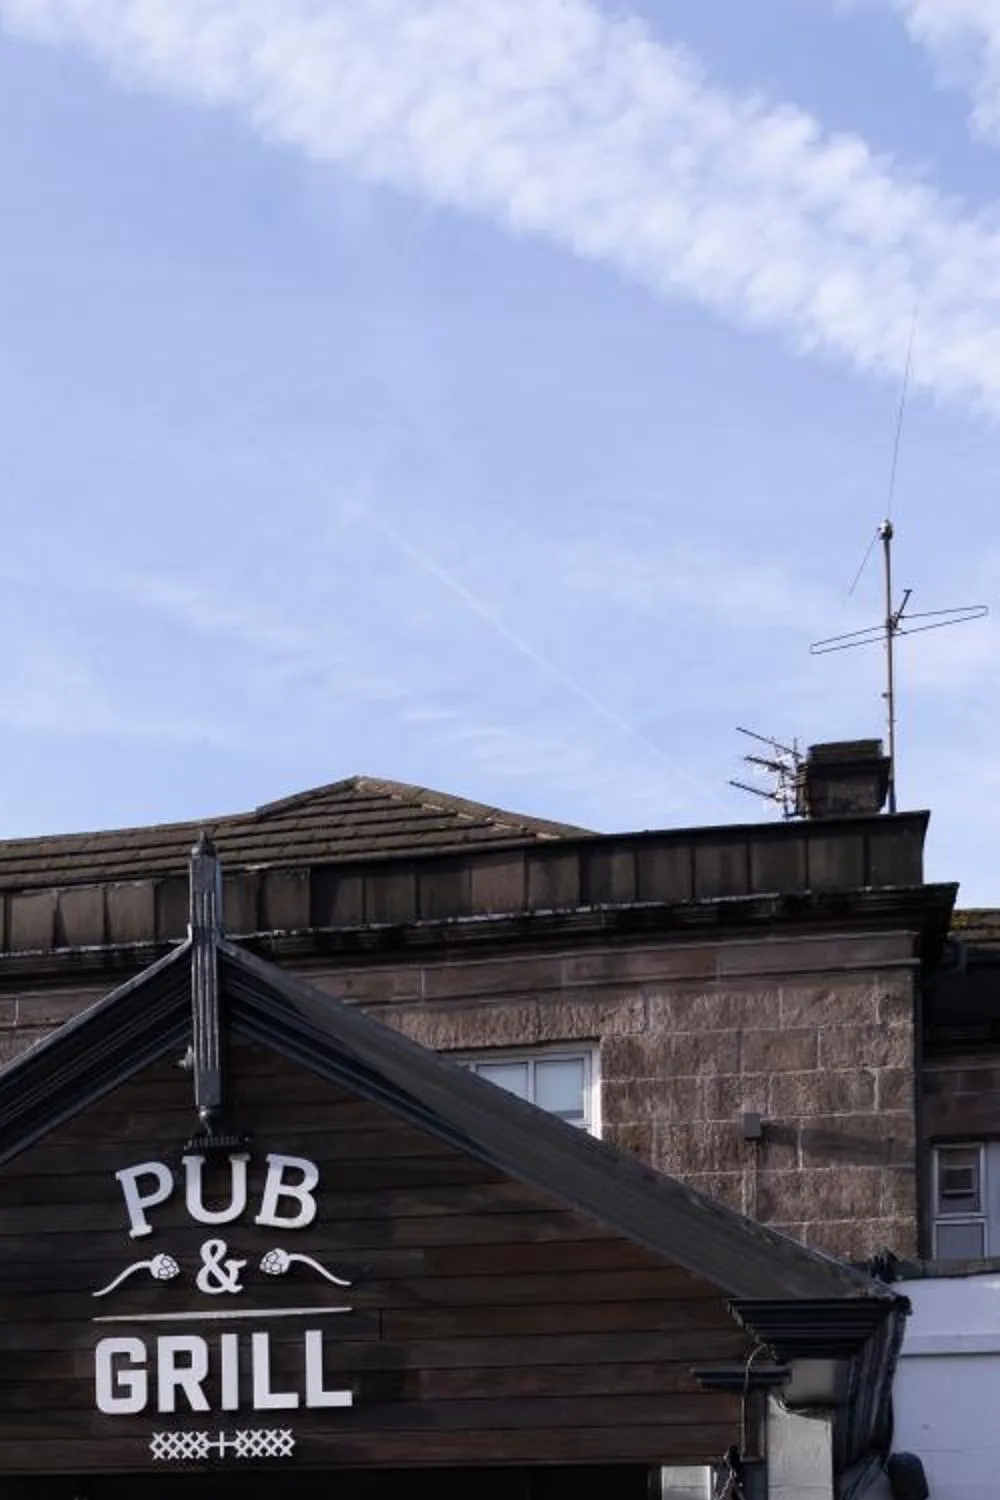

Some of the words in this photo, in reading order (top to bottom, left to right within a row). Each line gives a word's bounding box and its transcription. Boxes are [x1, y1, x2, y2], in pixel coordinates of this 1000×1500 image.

[115, 1153, 319, 1238] PUB
[196, 1239, 247, 1294] &
[95, 1329, 353, 1415] GRILL
